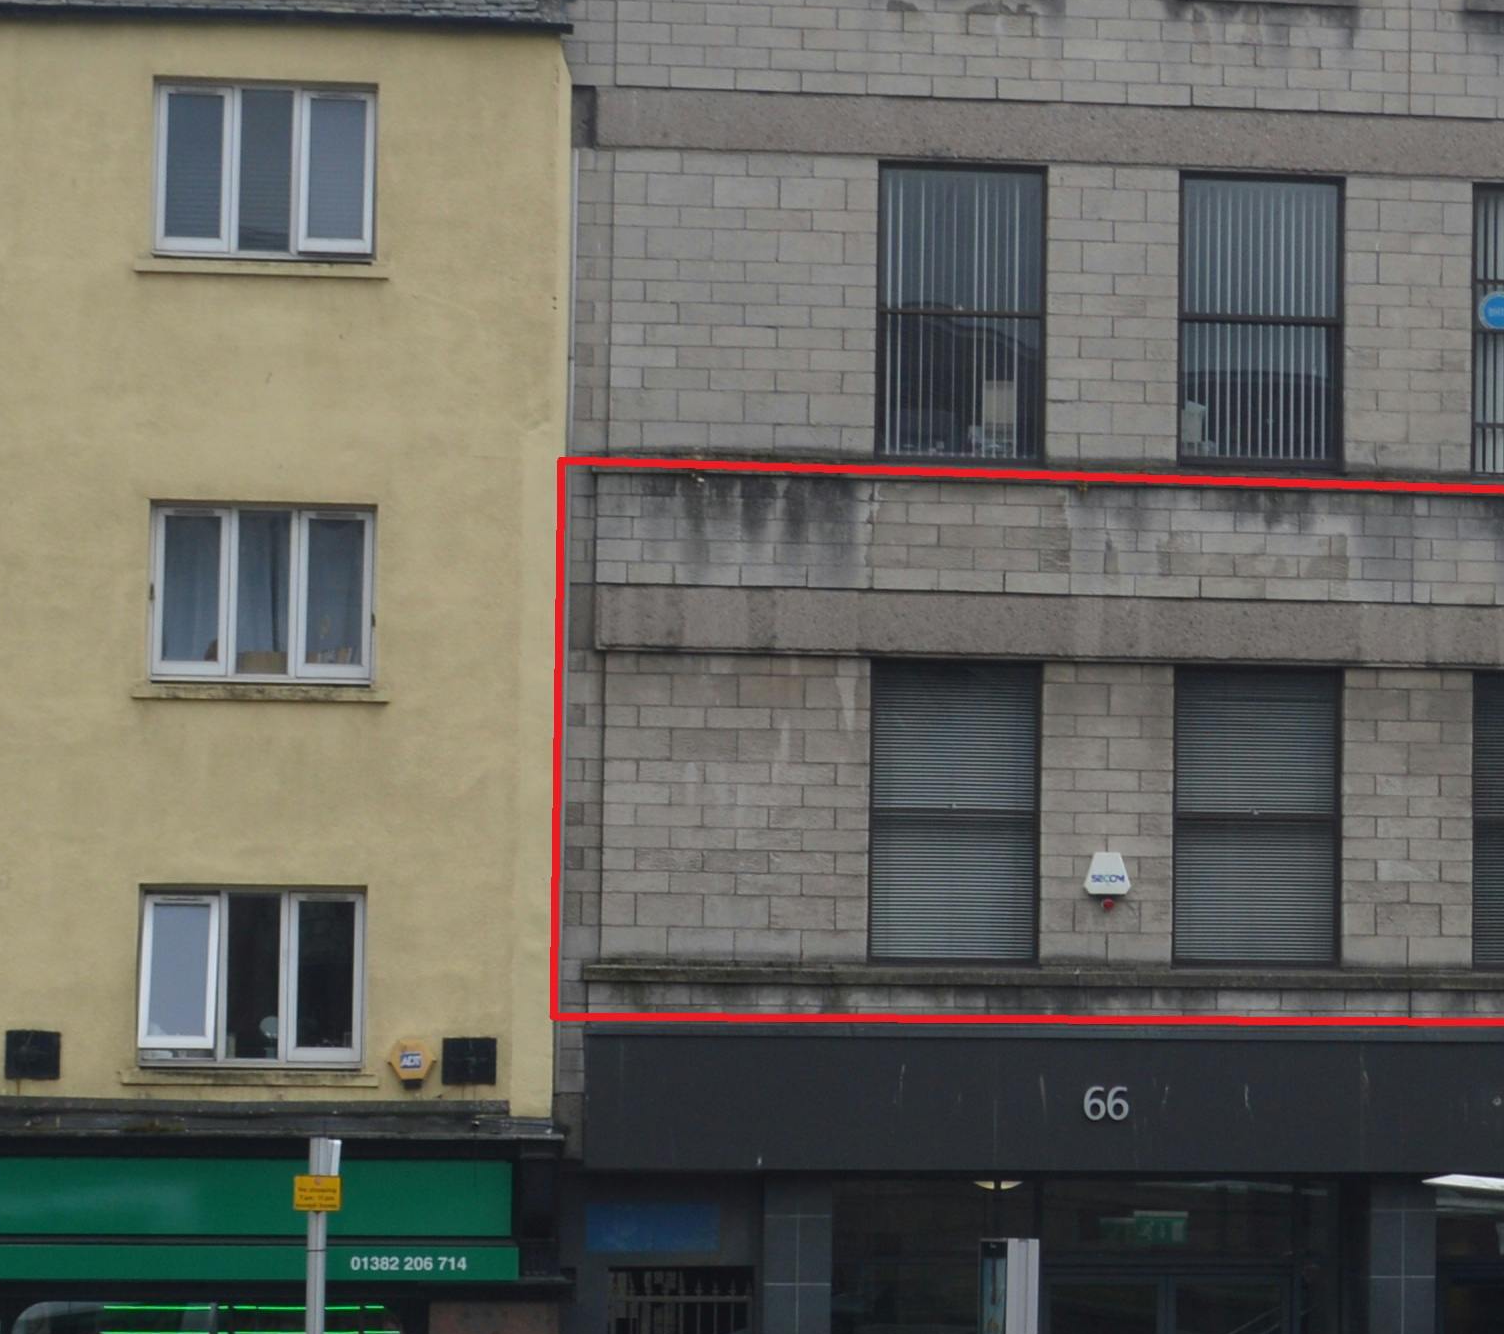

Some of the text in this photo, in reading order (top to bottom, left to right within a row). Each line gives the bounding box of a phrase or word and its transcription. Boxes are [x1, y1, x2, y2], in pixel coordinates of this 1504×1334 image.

[1091, 874, 1125, 884] SECOM
[1082, 1086, 1130, 1121] 66
[350, 1256, 467, 1271] 01382 206 714
